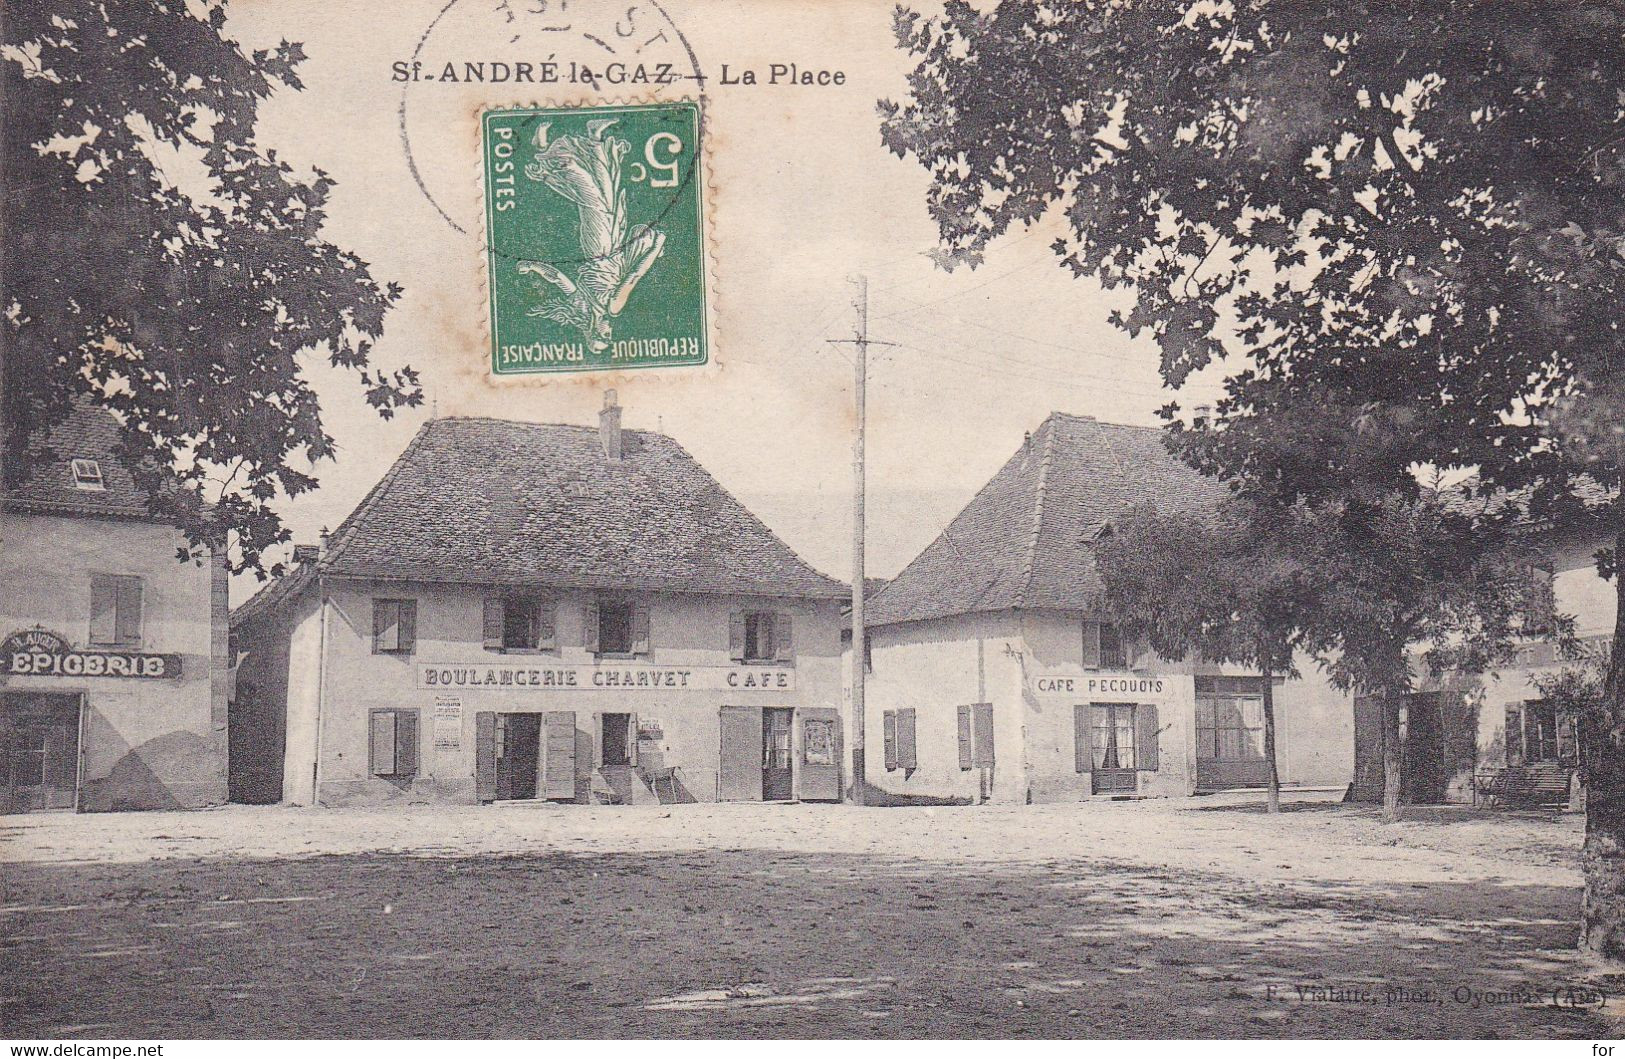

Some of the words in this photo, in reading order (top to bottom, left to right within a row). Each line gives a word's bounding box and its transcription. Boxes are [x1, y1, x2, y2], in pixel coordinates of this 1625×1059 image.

[494, 127, 515, 212] POSTES
[502, 341, 584, 364] FRANÇAISE
[10, 651, 165, 676] EPICERIE
[592, 670, 691, 687] CHARVET
[727, 672, 789, 688] CAFE
[1038, 679, 1074, 692] CAFE
